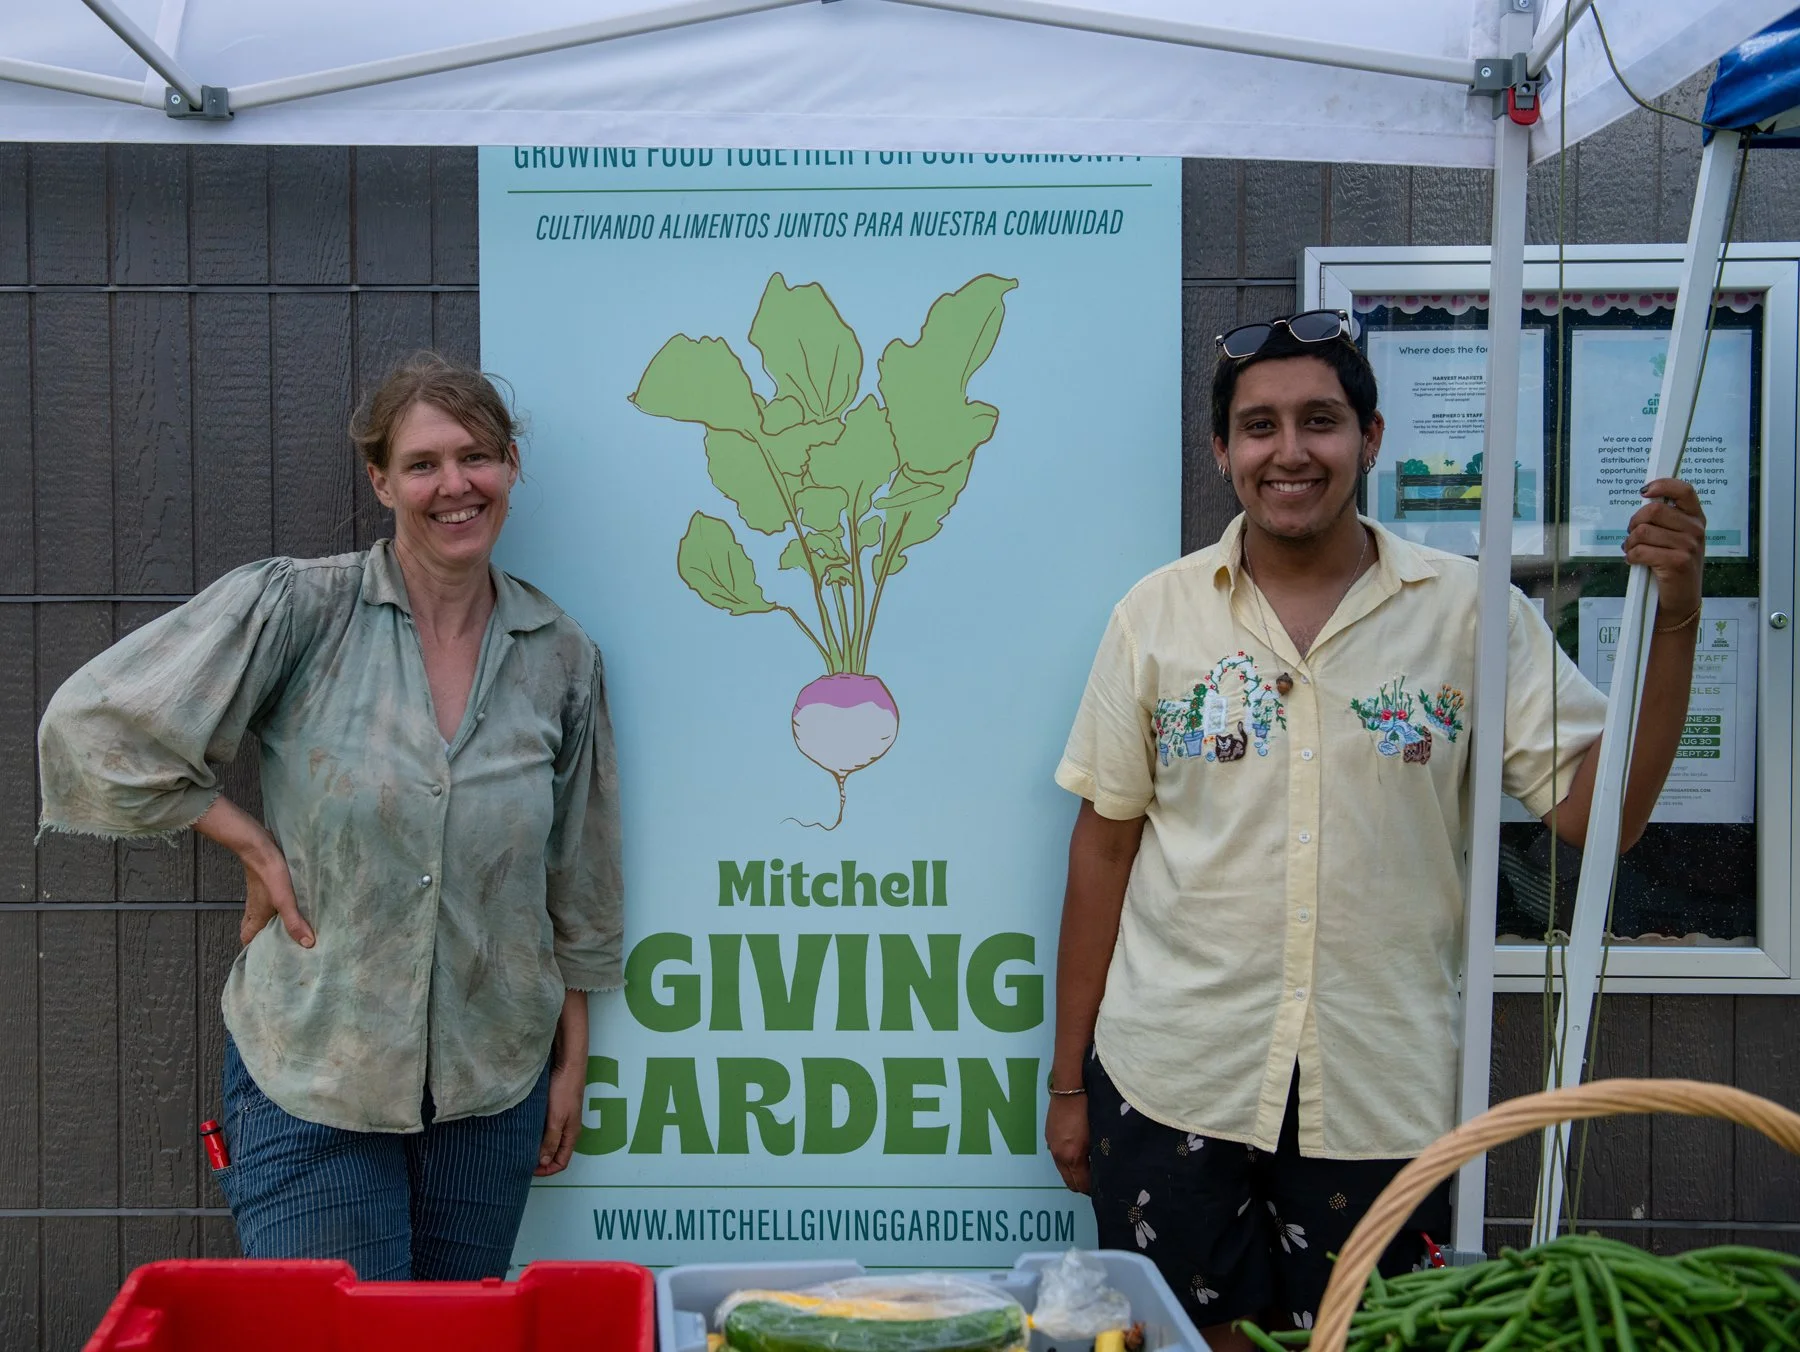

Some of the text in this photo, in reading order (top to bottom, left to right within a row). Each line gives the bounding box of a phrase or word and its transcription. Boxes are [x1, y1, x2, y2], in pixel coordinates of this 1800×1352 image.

[514, 146, 636, 168] GROWING
[536, 209, 1124, 240] CULTIVANDO ALIMENTOS JUNTOS PARA NUESTRA COMUNIDAD
[1398, 346, 1430, 354] Where
[1432, 346, 1456, 354] does
[1458, 346, 1474, 354] the
[1598, 446, 1626, 454] project
[1687, 436, 1723, 444] ardening
[718, 858, 948, 908] Mitchell
[624, 932, 1044, 1033] GIVING
[575, 1055, 1051, 1157] GARDEN
[593, 1209, 1076, 1242] WWW.MITCHELLGIVINGGARDENS.COM
